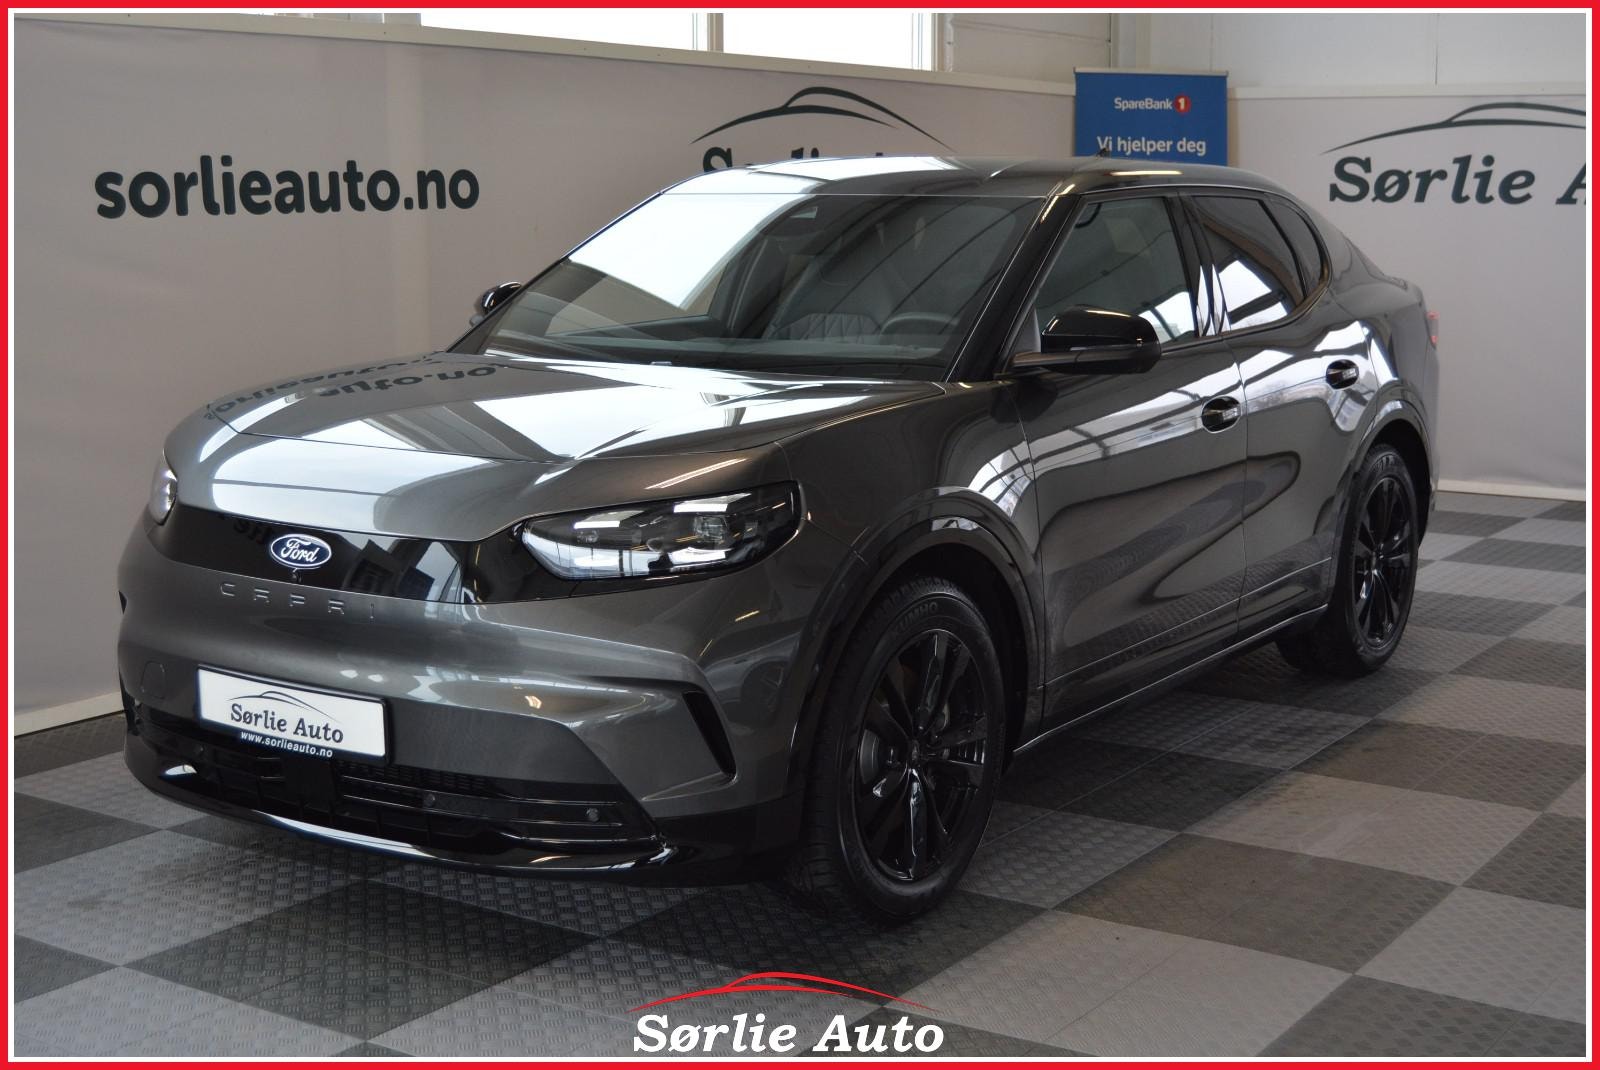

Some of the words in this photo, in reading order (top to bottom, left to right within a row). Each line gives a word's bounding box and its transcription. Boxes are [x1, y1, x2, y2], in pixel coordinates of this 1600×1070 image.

[1114, 97, 1172, 111] SpareBank
[1096, 136, 1112, 151] Vi
[1117, 136, 1173, 155] hjelper
[1176, 138, 1206, 156] deg
[94, 155, 480, 219] sorlieauto.no
[1329, 155, 1536, 204] Sørlie
[280, 537, 320, 563] Ford
[220, 582, 376, 619] CAPRI
[230, 703, 287, 732] Sørlie
[293, 717, 344, 743] Auto
[240, 731, 333, 758] www.sorlieauto.no
